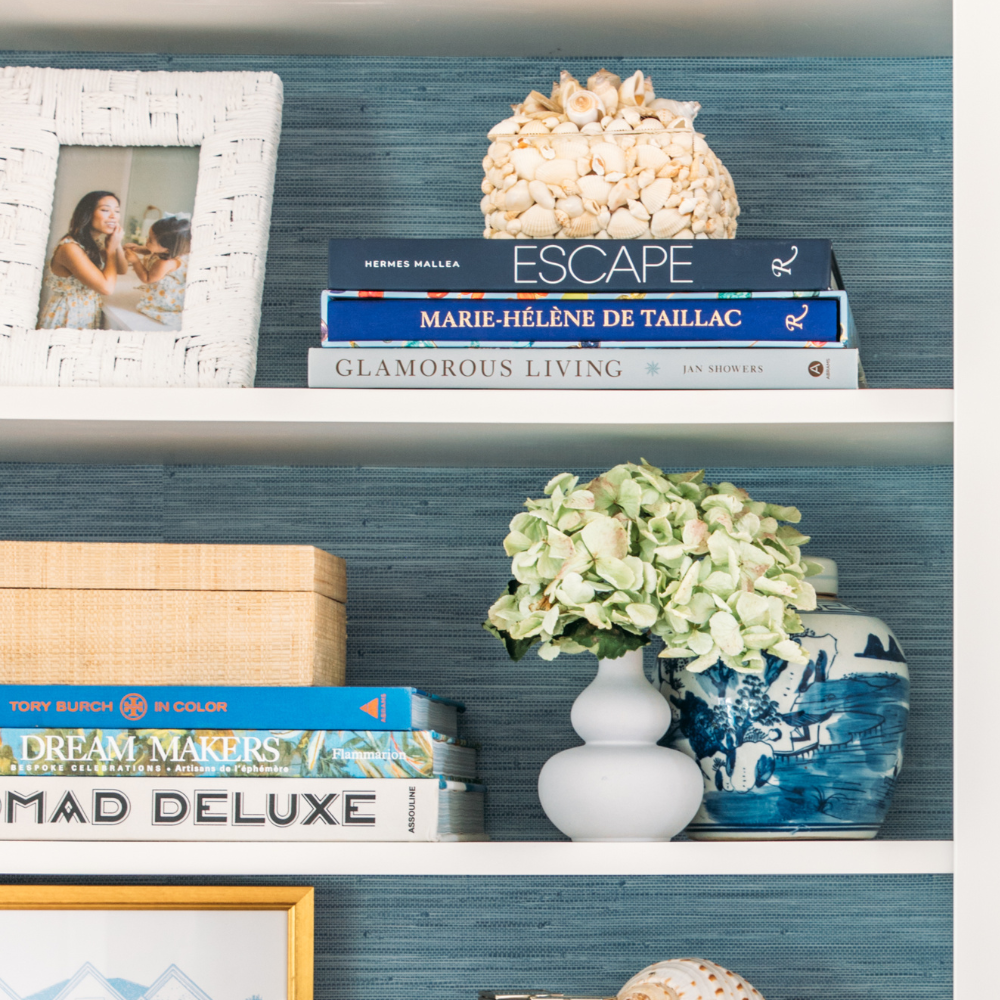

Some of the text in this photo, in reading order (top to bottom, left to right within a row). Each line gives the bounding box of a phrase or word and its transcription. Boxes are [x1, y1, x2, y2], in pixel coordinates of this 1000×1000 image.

[364, 259, 461, 269] HERMES MALLEA
[513, 244, 694, 285] ESCAPE
[419, 305, 742, 329] MARIE-HÉLÈNE DE TAILLAC
[335, 357, 623, 378] GLAMOROUS LIVING
[683, 364, 764, 375] JAN SHOWERS
[9, 701, 228, 713] TORY BURCH IN COLOR
[20, 735, 281, 763] DREAM MAKERS
[332, 747, 407, 761] Flammarion
[10, 764, 64, 772] BESPOKE
[71, 764, 162, 773] CELEBRATIONS
[175, 764, 215, 773] Artisans
[219, 764, 232, 773] de
[0, 788, 377, 827] MAD DELUXE
[407, 785, 416, 834] ASSOULINE
